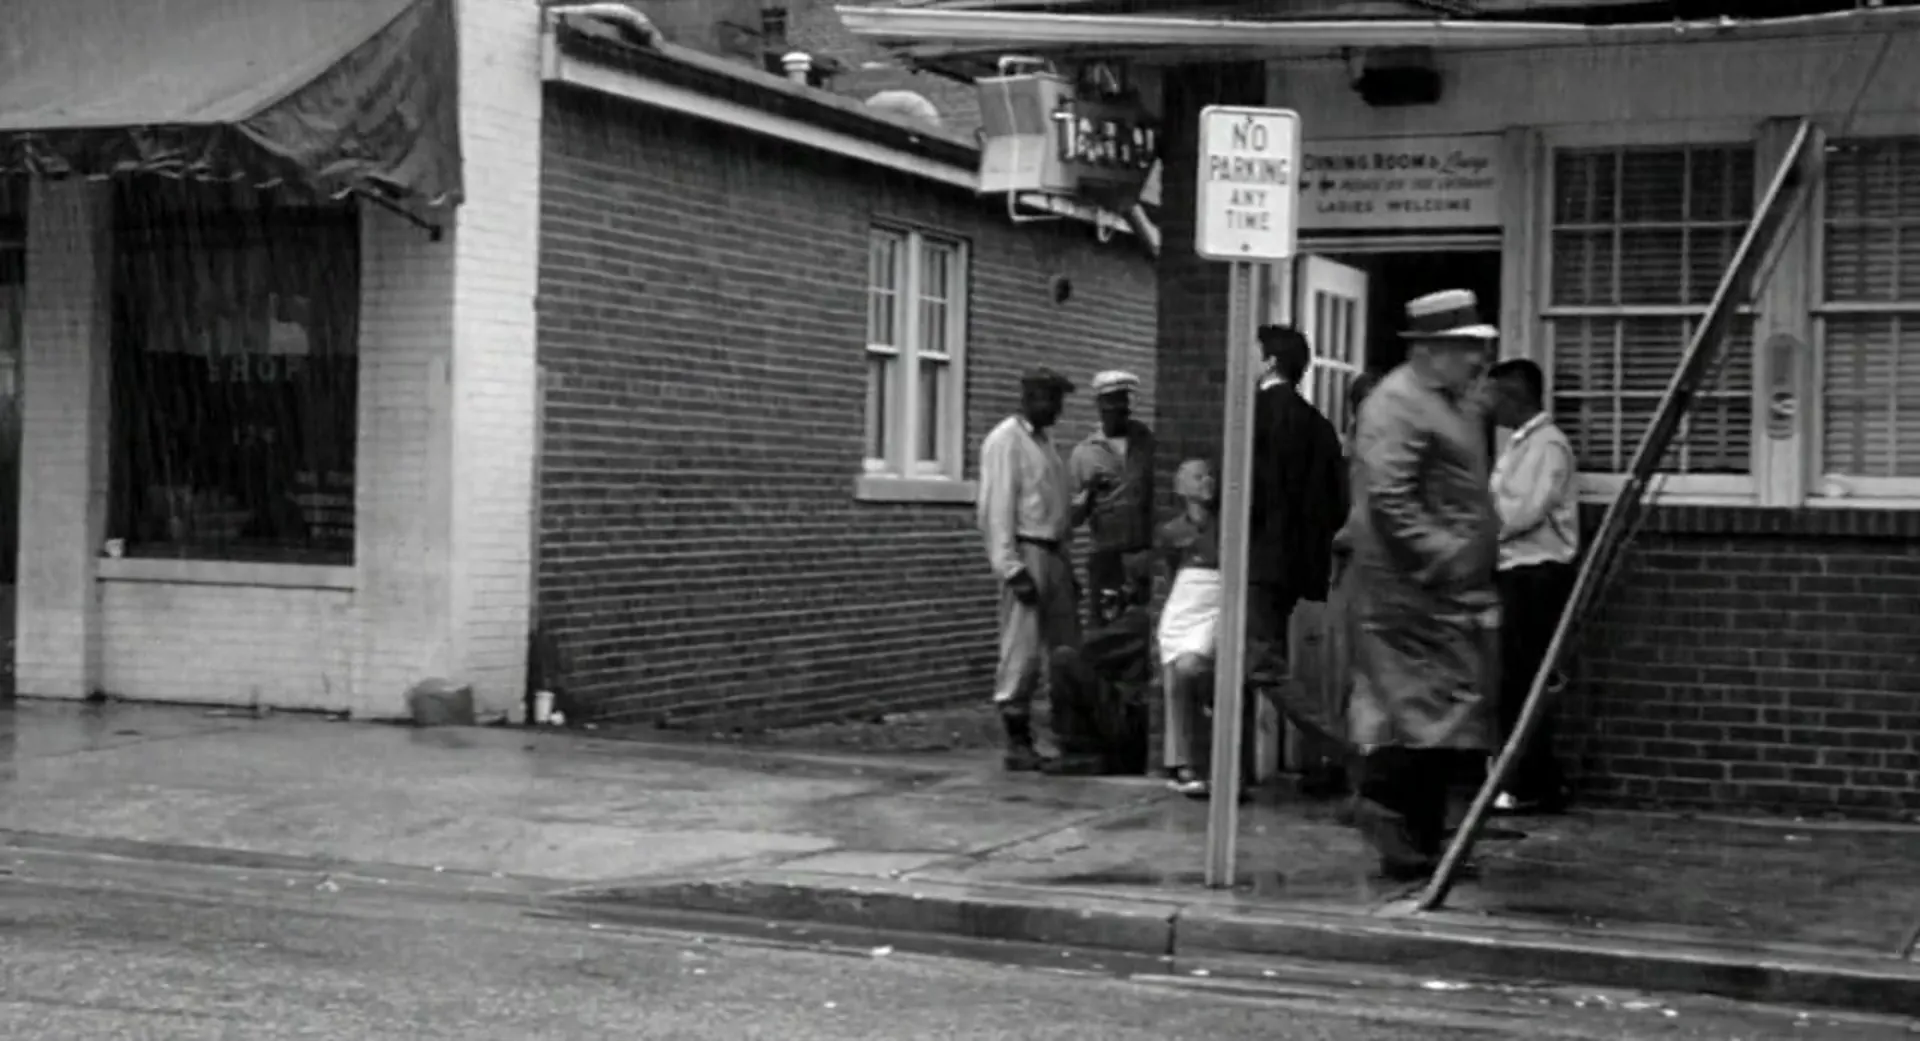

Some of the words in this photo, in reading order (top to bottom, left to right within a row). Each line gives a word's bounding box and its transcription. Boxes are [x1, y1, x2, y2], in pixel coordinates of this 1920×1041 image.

[1232, 121, 1268, 151] NO
[1211, 155, 1288, 186] PARKING
[1303, 154, 1368, 171] DINING
[1373, 153, 1426, 170] ROOM
[1231, 188, 1267, 207] ANY
[1317, 200, 1375, 213] LADIES
[1386, 199, 1472, 213] WELCOME
[1225, 209, 1271, 231] TIME
